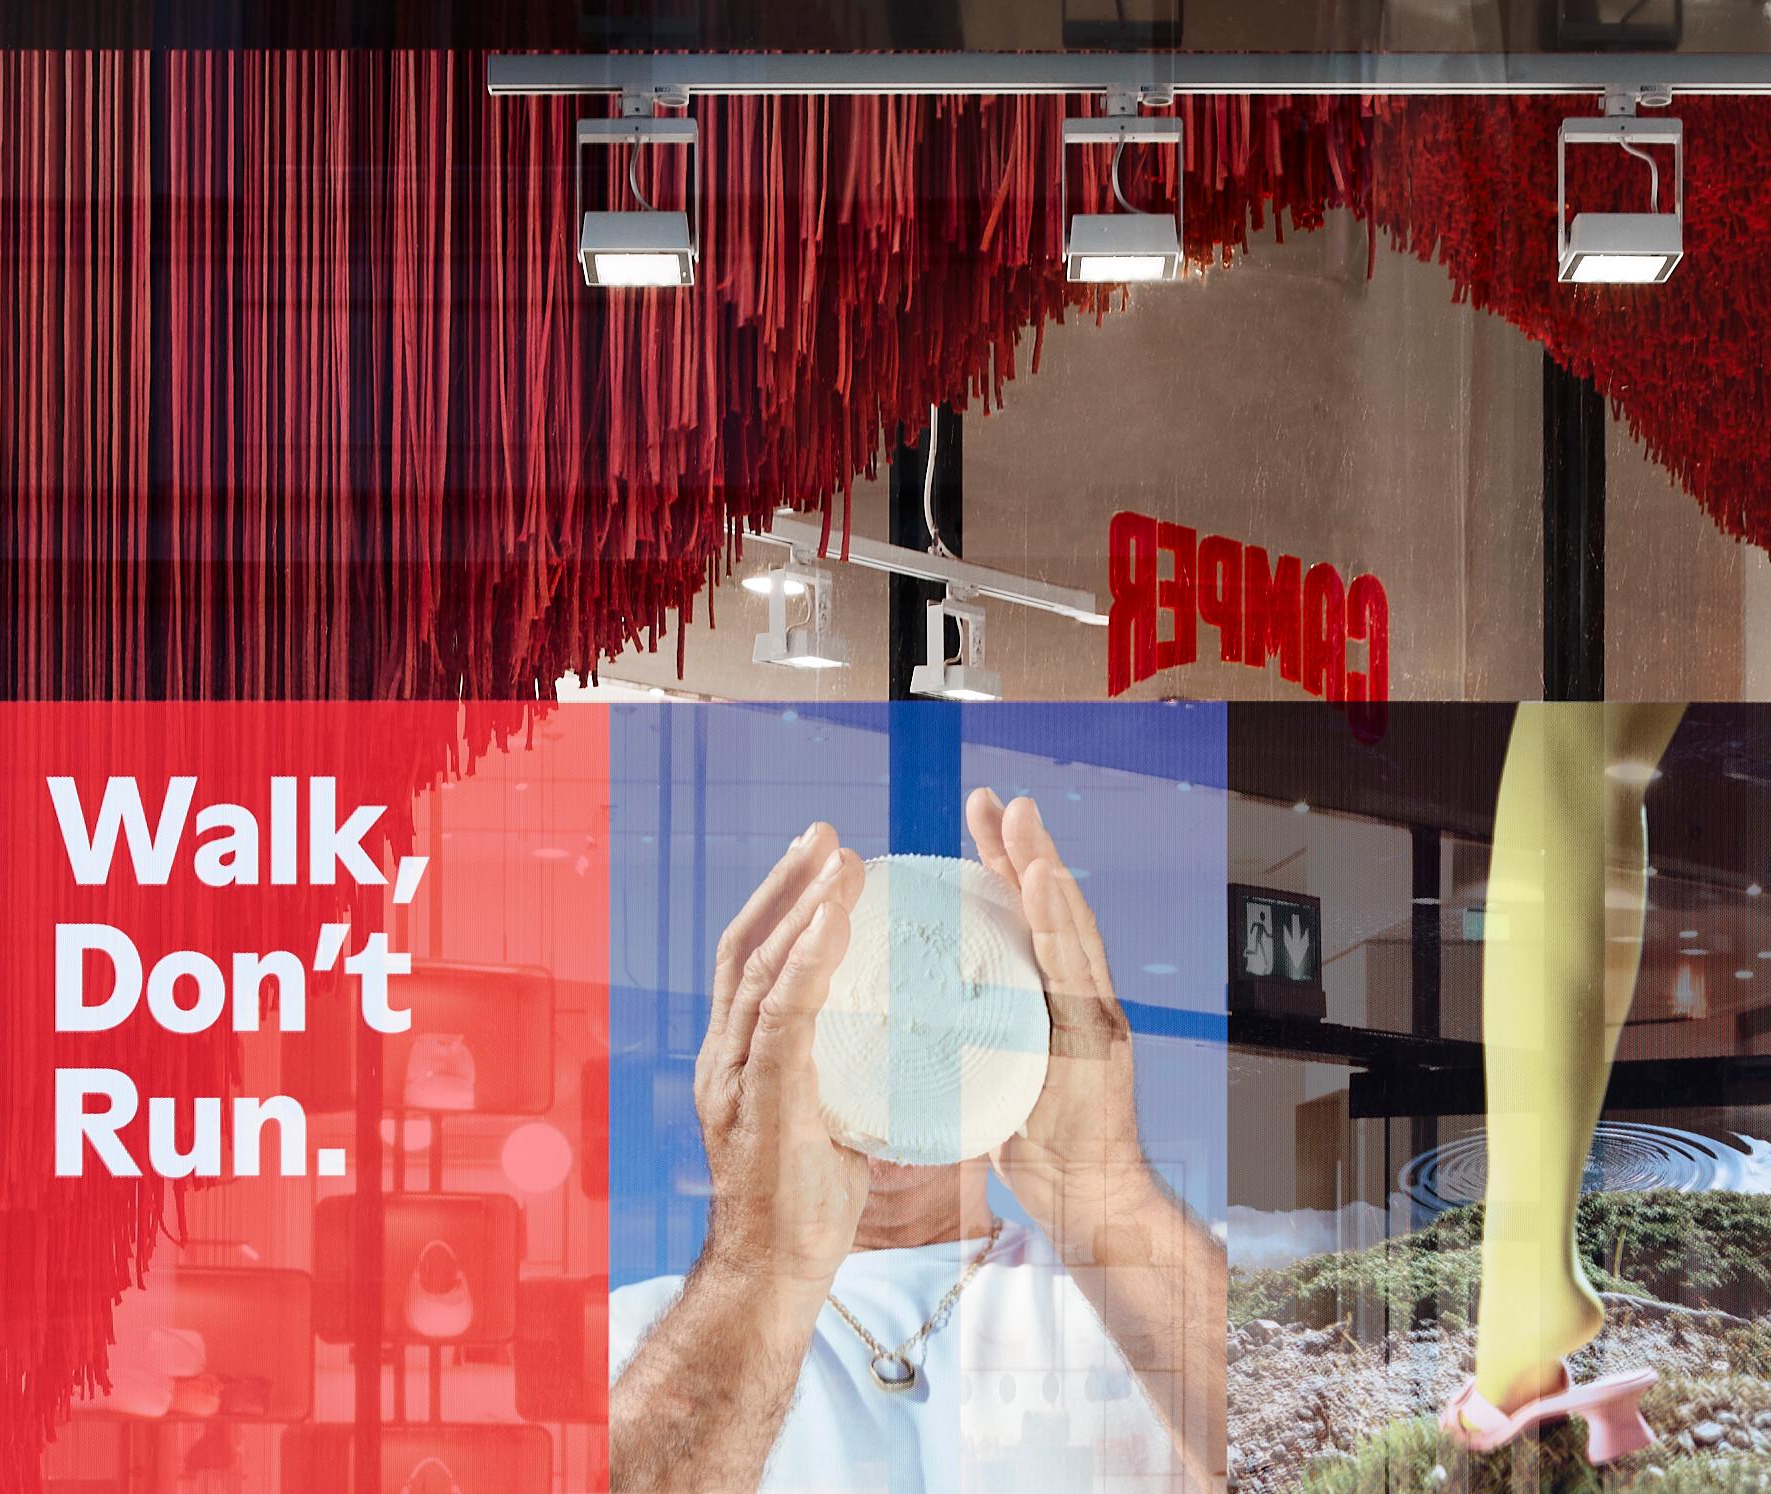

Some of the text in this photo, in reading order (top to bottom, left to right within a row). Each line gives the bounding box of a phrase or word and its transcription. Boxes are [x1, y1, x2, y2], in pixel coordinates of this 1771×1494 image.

[46, 776, 430, 904] Walk,
[55, 923, 412, 1034] Don’t
[55, 1068, 346, 1178] Run.
